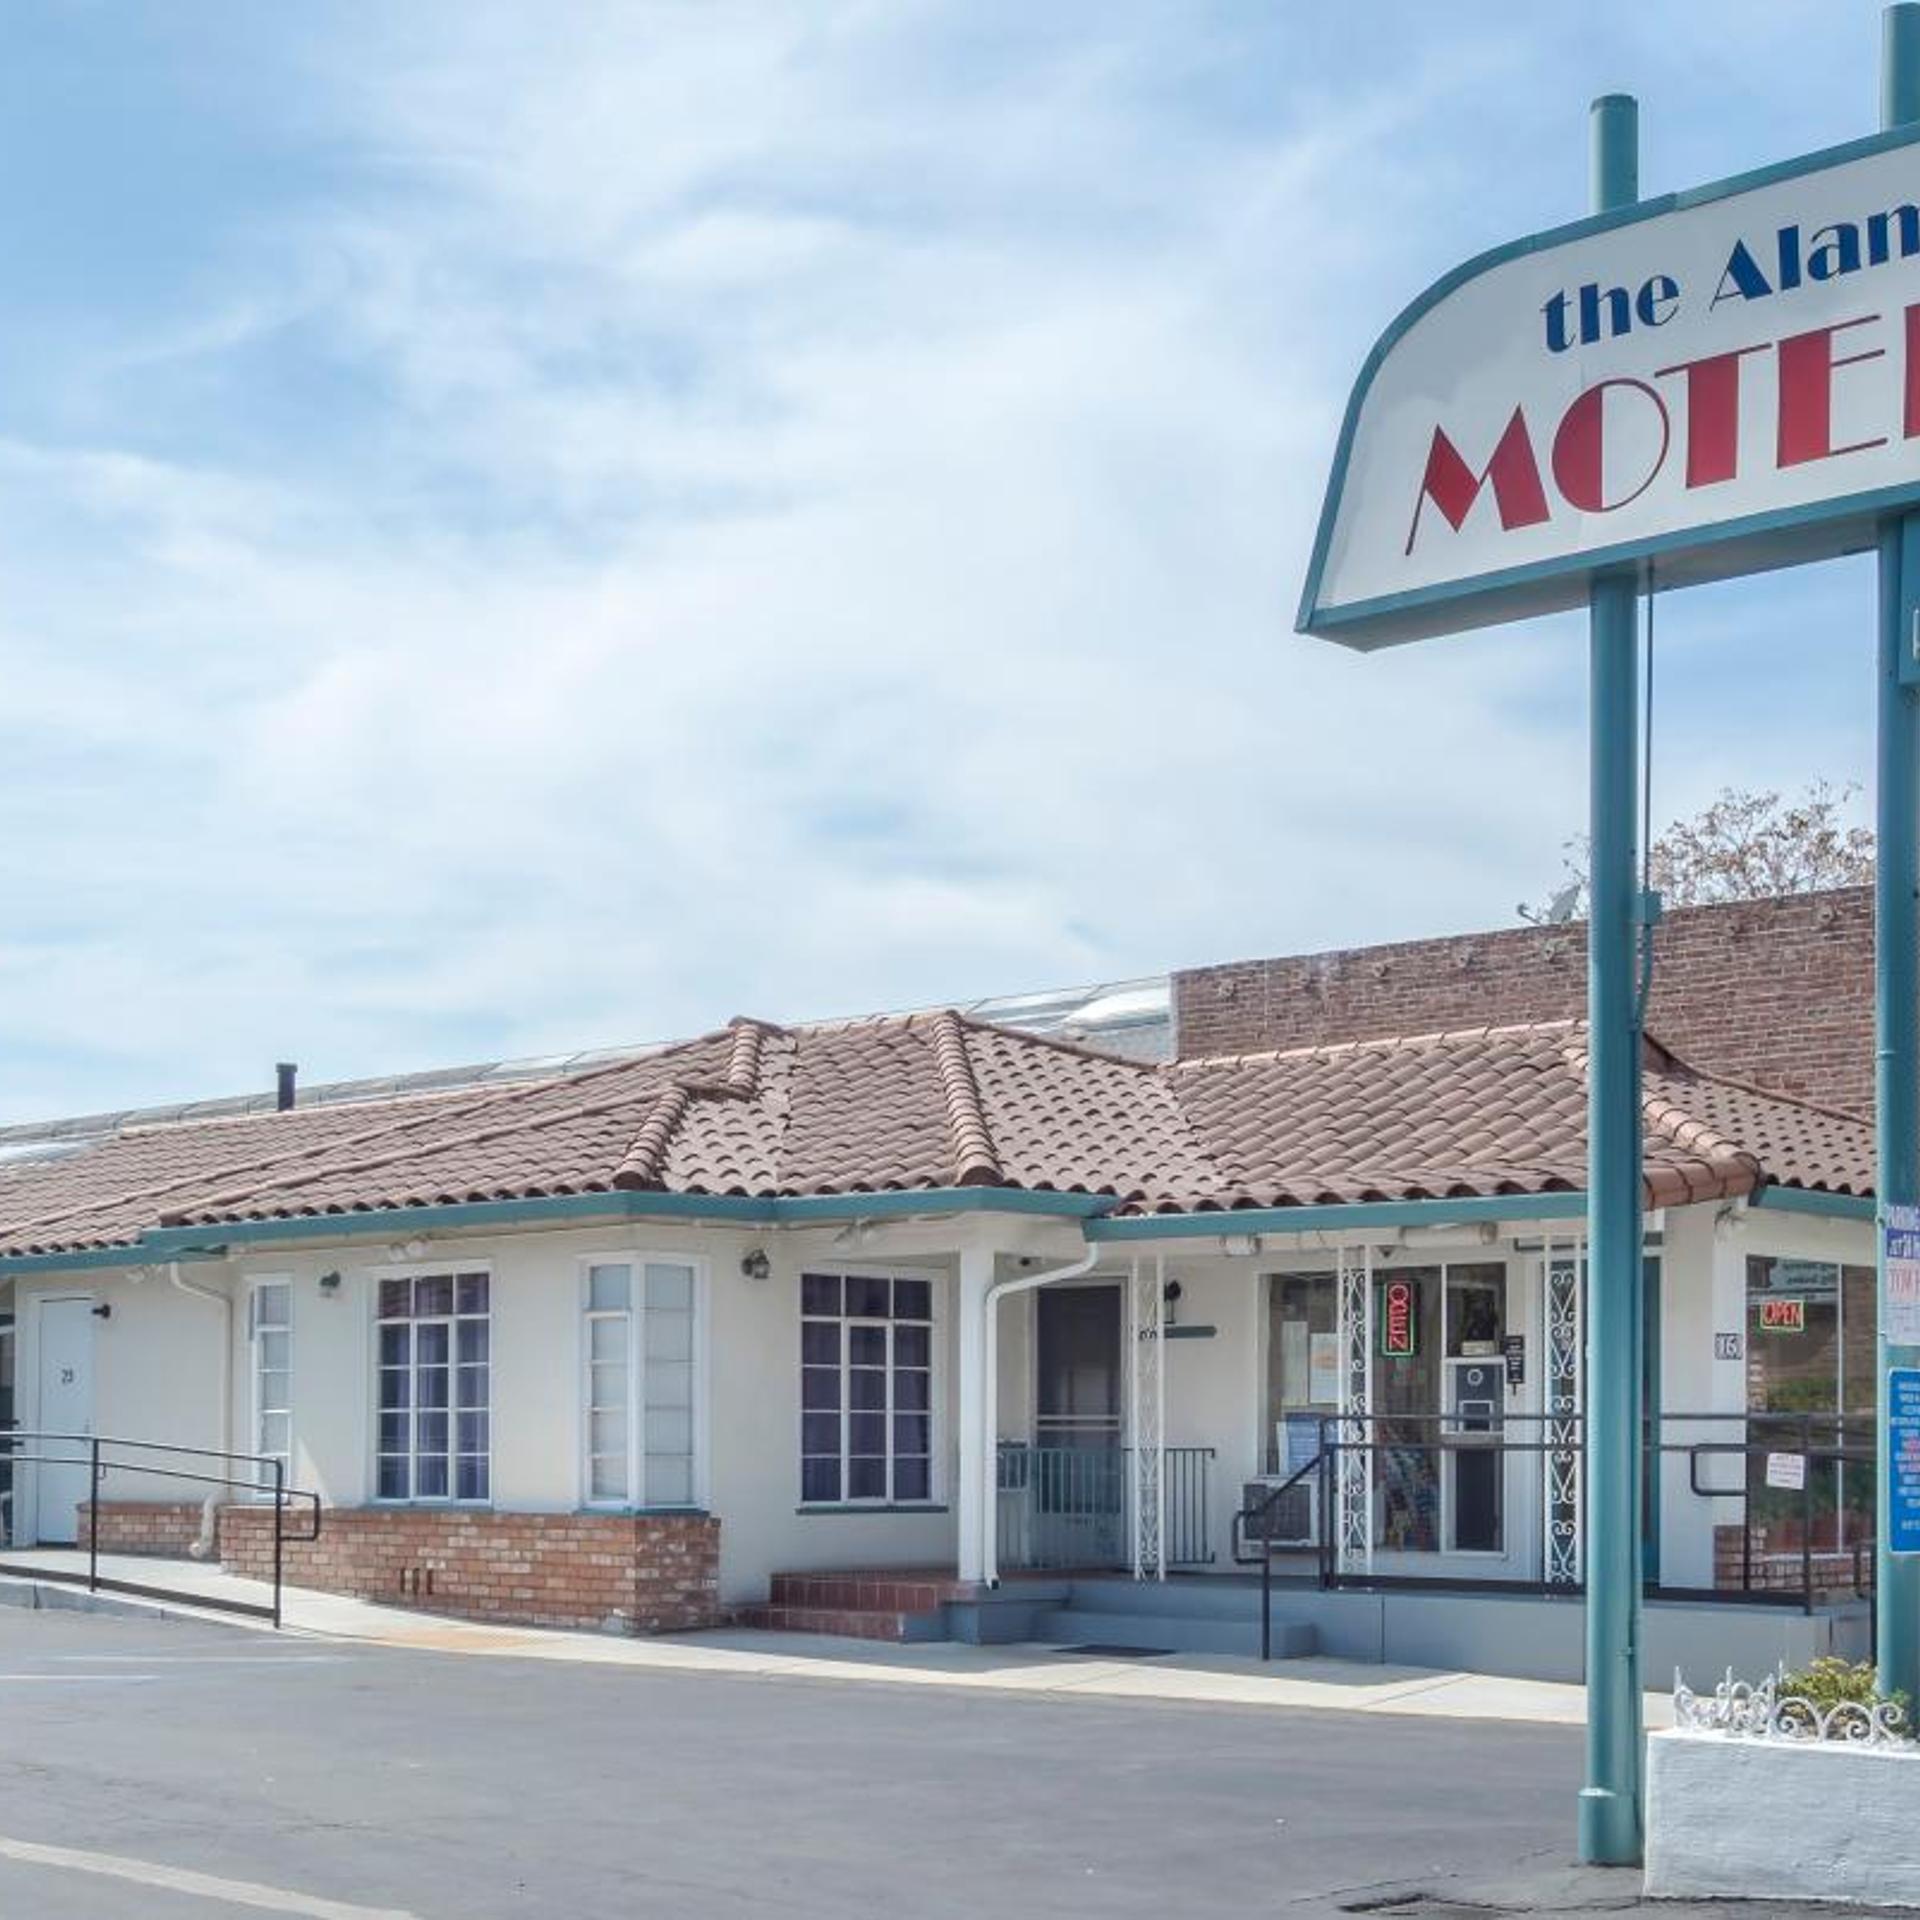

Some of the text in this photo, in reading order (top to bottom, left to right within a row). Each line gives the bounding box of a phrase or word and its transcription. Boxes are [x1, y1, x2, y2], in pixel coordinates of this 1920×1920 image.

[1540, 274, 1679, 353] the
[1404, 303, 1920, 556] MOTE
[1388, 1284, 1409, 1352] OPEN
[1763, 1301, 1802, 1326] OPEN
